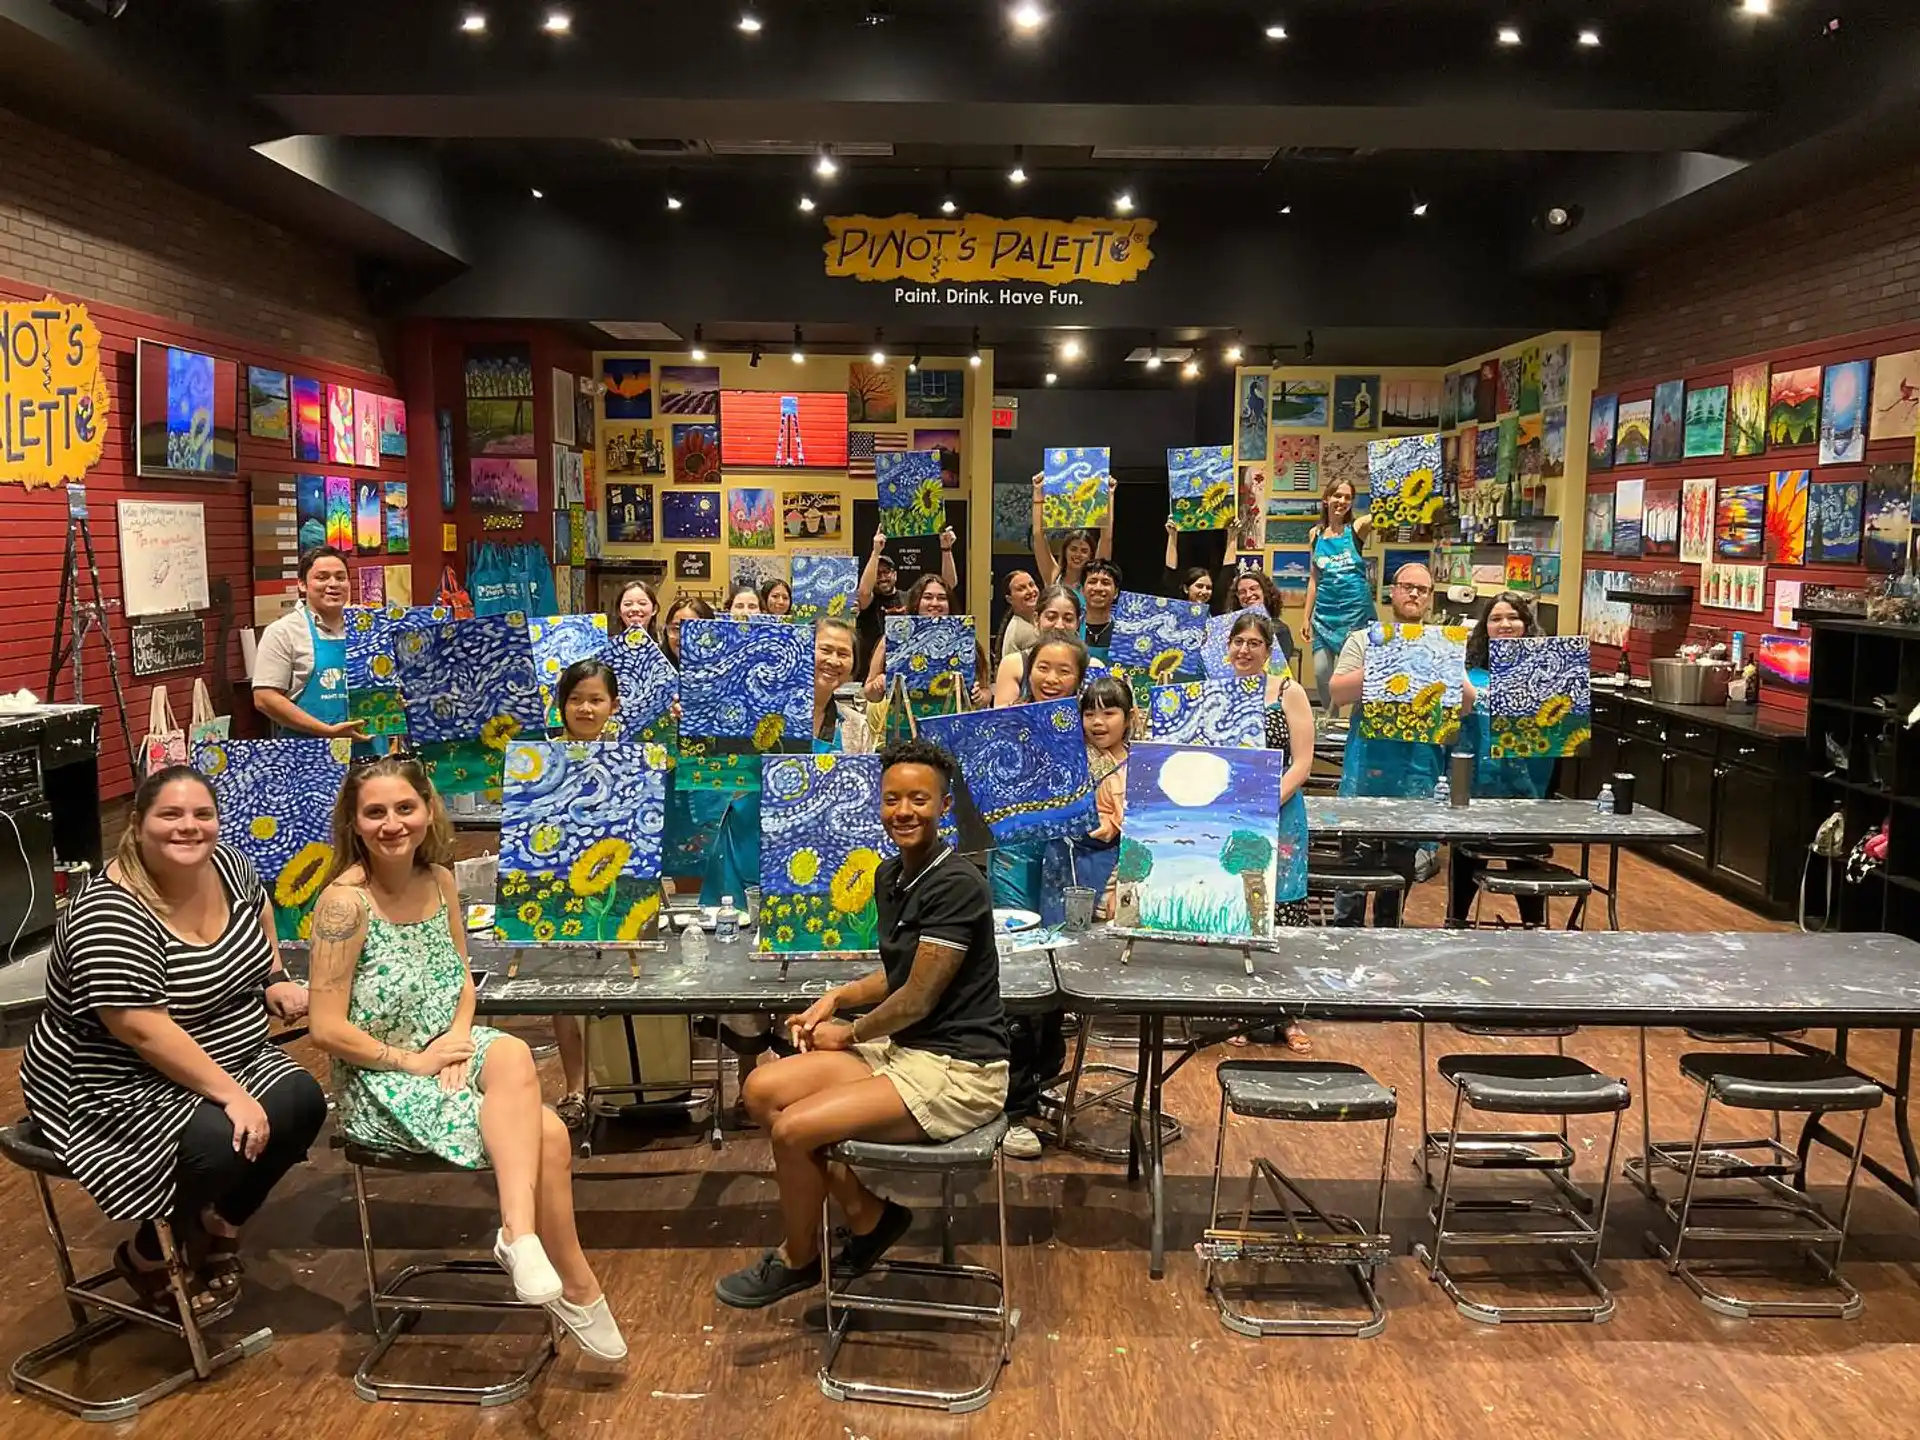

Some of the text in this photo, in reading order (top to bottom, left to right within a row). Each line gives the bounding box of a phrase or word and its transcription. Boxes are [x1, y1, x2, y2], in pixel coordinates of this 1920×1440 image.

[837, 227, 978, 279] PINOT'S
[894, 288, 1083, 306] Paint. Drink. Have Fun.
